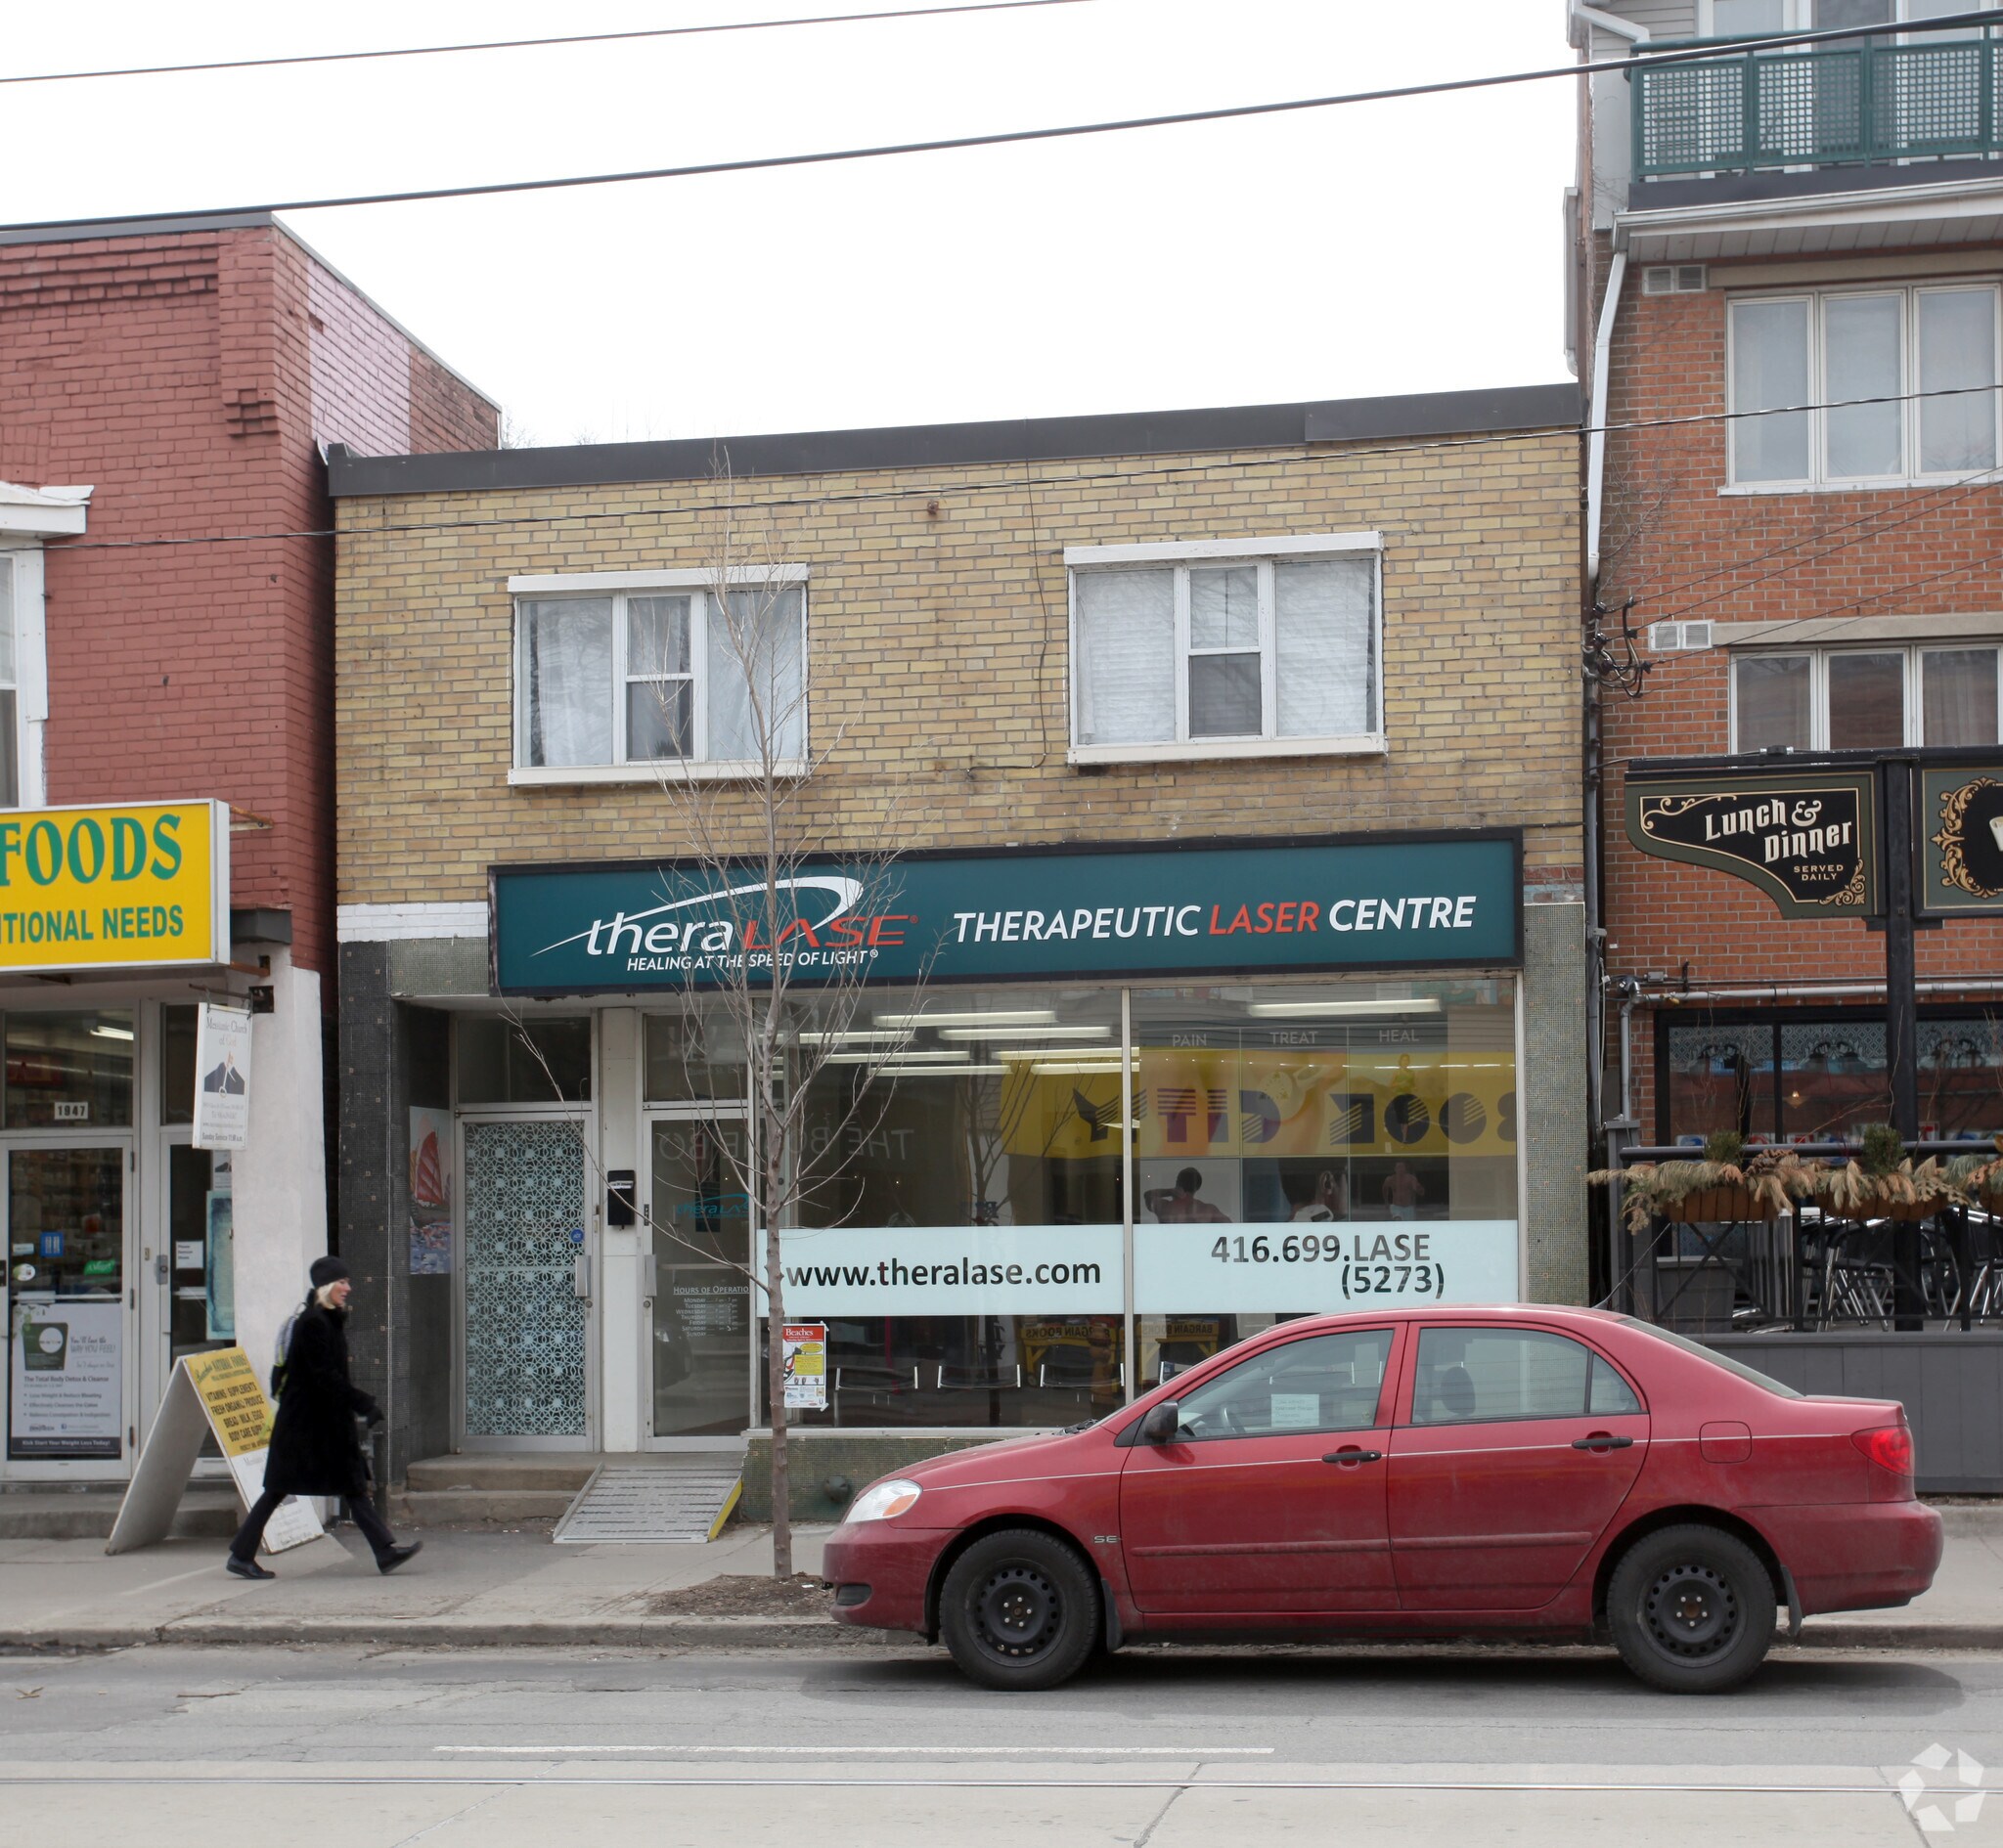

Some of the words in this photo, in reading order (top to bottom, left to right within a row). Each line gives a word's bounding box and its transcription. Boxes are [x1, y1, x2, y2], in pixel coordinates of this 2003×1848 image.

[1705, 799, 1786, 842] Lunch
[1792, 800, 1822, 826] &
[0, 814, 183, 886] FOODS
[1763, 821, 1851, 863] Dinner
[1793, 864, 1844, 873] SERVED
[0, 909, 94, 945] TIONAL
[103, 904, 184, 940] NEEDS
[953, 904, 1201, 943] THERAPEUTIC
[1209, 902, 1320, 935] LASER
[1328, 896, 1477, 931] CENTRE
[627, 956, 692, 971] HEALING
[693, 955, 715, 969] AT
[717, 955, 743, 968] THE
[748, 952, 793, 967] SPEED
[797, 951, 820, 966] OF
[1173, 1034, 1207, 1047] PAIN
[1269, 1031, 1318, 1044] TREAT
[1379, 1030, 1419, 1043] HEAL
[58, 1106, 86, 1117] 1947
[1211, 1234, 1430, 1262] 416.699.LASE
[785, 1257, 1101, 1287] www.theralase.com
[1341, 1262, 1446, 1300] (5273)
[712, 1285, 749, 1294] OPERATIO
[785, 1328, 814, 1337] Beaches
[205, 1388, 227, 1402] VITAMINS
[227, 1382, 257, 1397] SUPPLEMENTS
[211, 1405, 226, 1416] FRESH
[244, 1394, 264, 1406] PRODUCE
[223, 1416, 240, 1429] BREAD
[251, 1409, 264, 1421] EGGS
[228, 1430, 241, 1442] BODY
[240, 1427, 252, 1438] CARE
